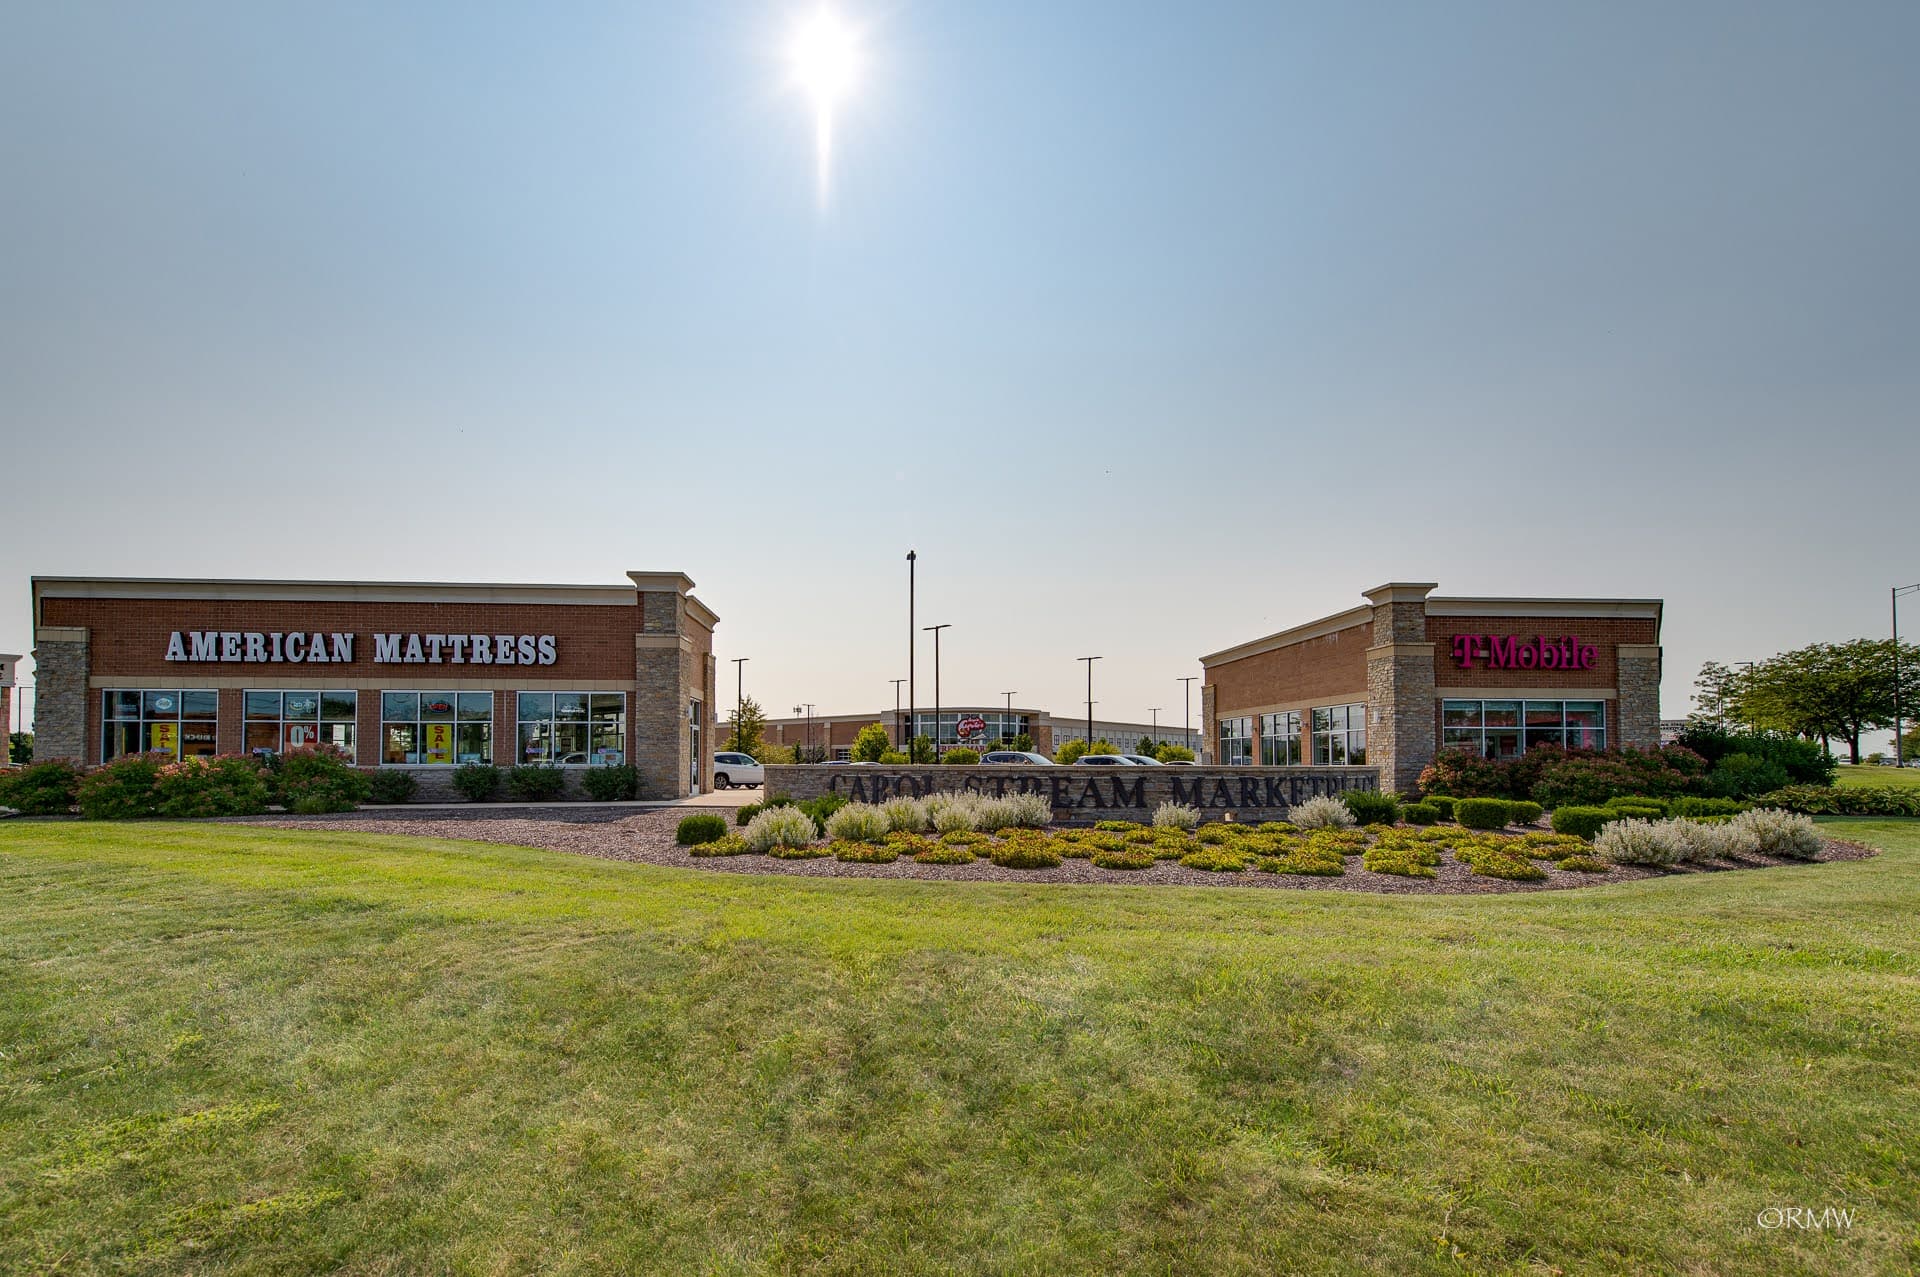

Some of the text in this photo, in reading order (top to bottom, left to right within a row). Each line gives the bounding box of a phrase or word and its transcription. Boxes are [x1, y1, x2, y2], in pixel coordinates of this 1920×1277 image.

[165, 631, 557, 666] AMERICAN MATTRESS
[290, 725, 315, 748] 0%
